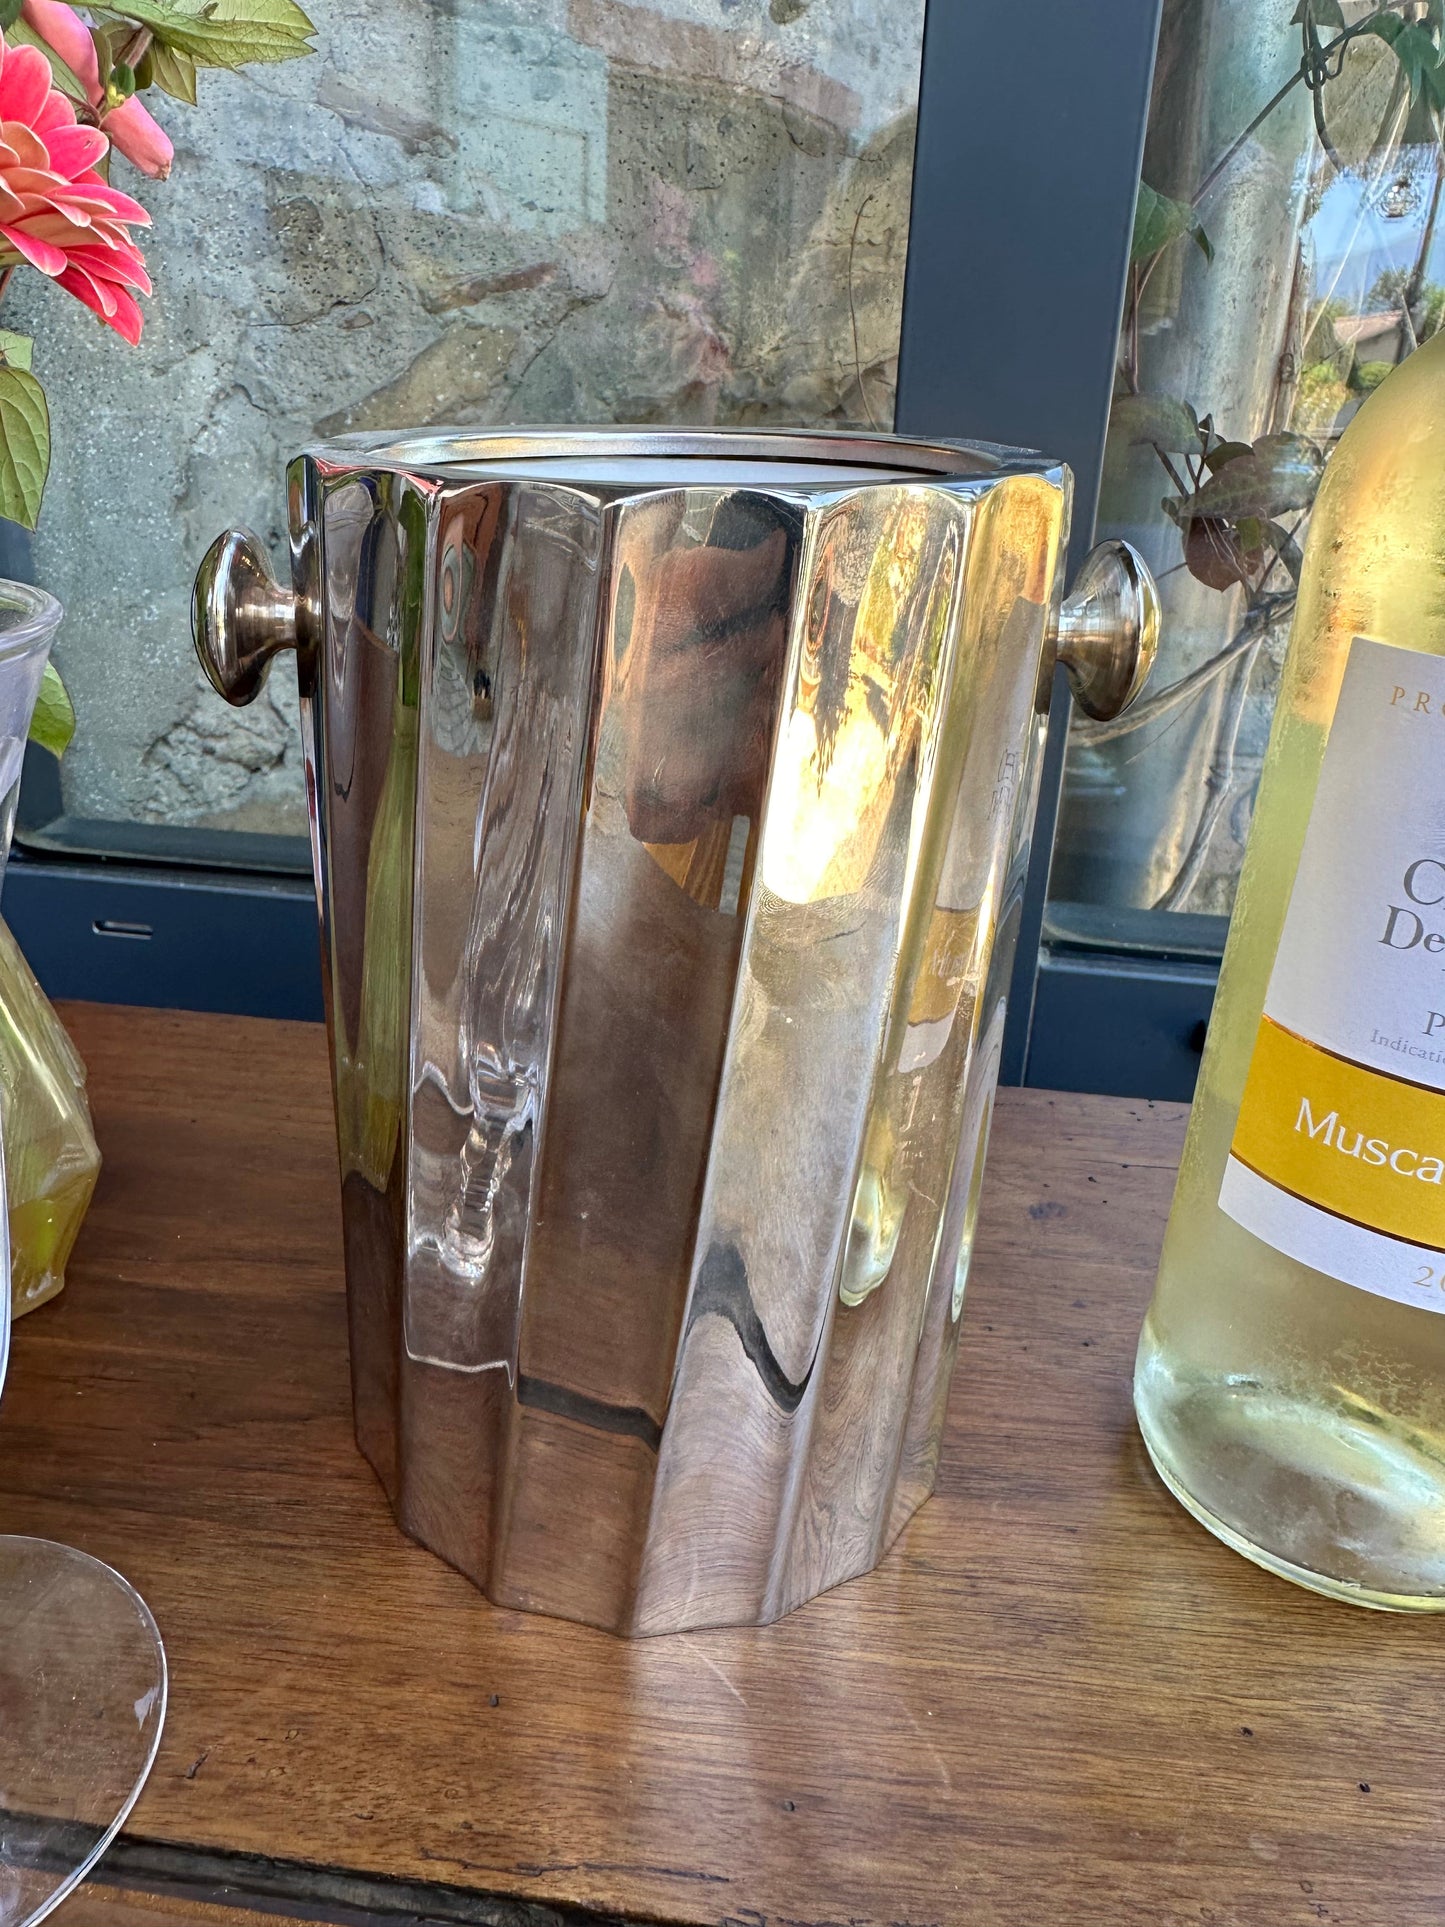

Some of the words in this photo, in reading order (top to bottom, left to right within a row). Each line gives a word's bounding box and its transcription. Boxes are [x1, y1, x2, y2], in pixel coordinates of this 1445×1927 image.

[1390, 685, 1445, 717] PR
[1370, 1029, 1445, 1064] Indicati
[1294, 1097, 1445, 1185] Musca
[1411, 1266, 1445, 1292] 2
